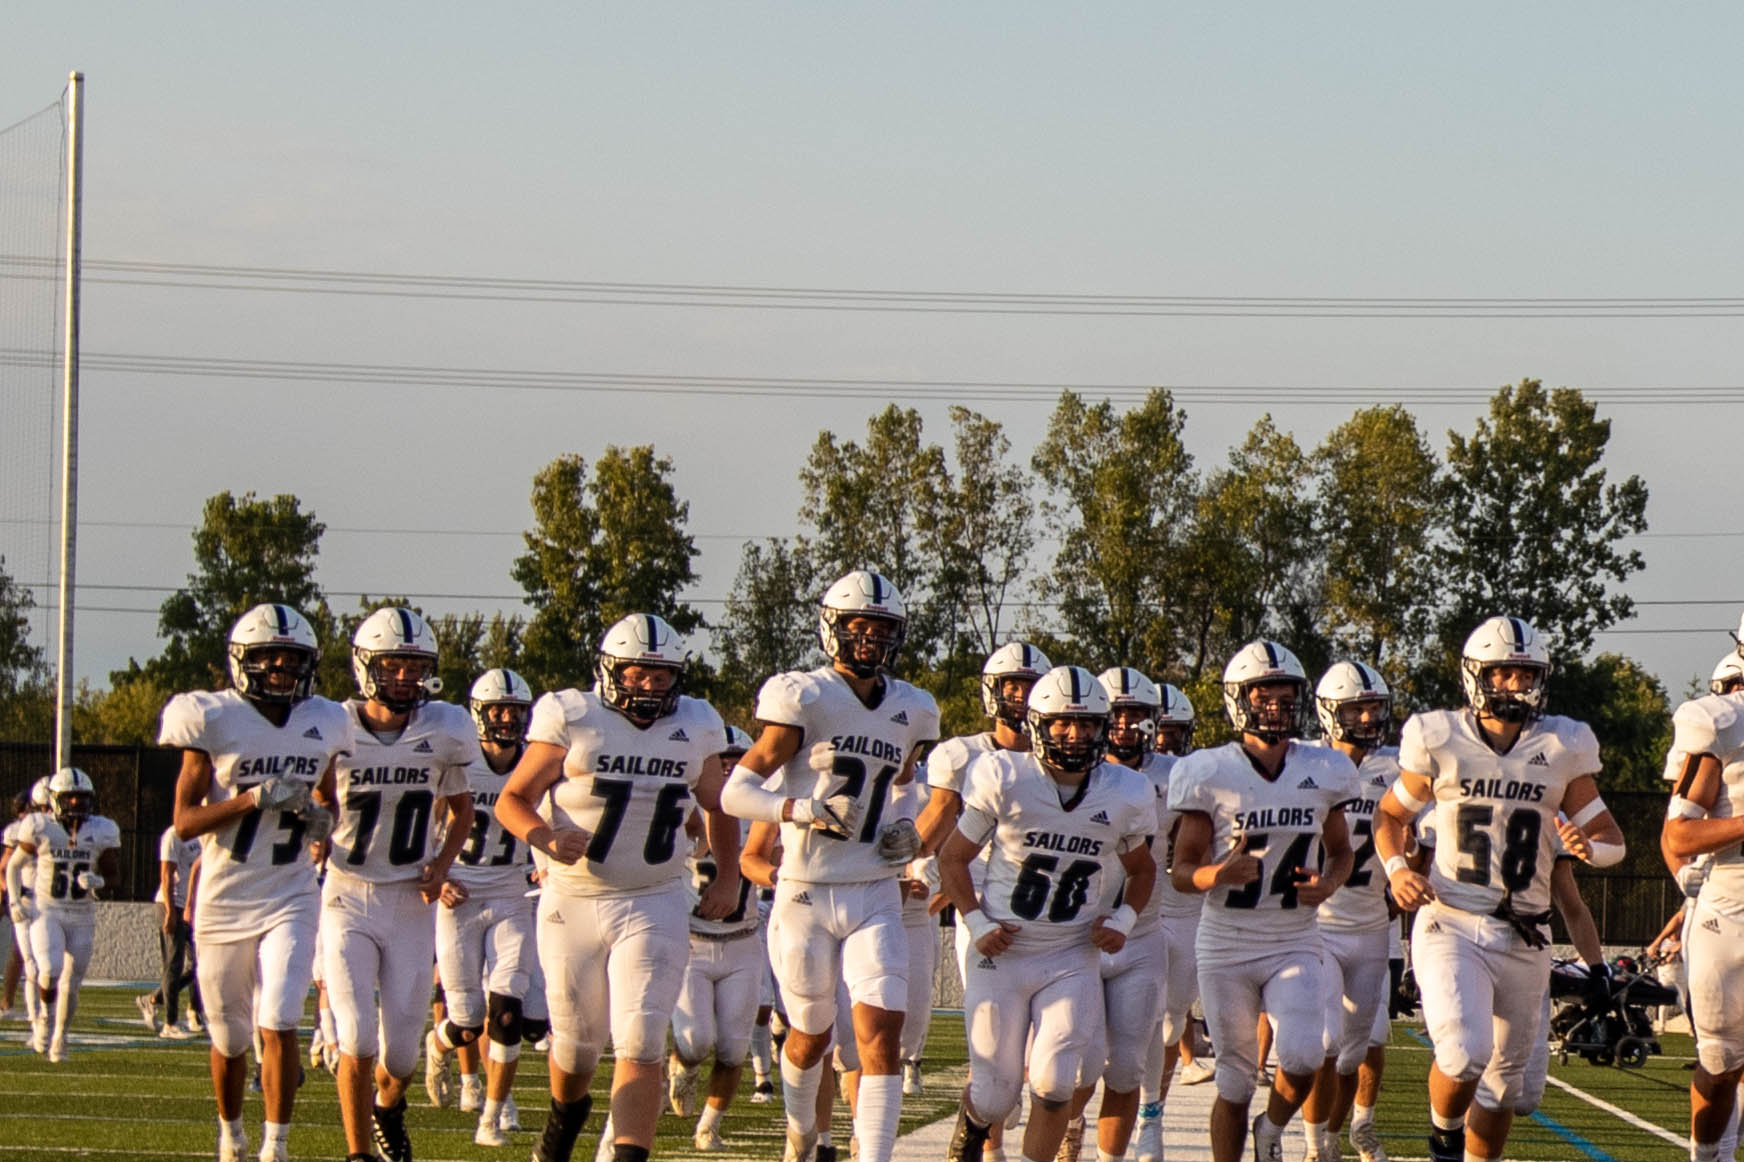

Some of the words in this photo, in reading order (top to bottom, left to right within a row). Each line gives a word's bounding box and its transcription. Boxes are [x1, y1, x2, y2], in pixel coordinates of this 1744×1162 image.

[828, 735, 902, 765] SAILORS
[239, 756, 319, 777] SAILORS
[350, 767, 430, 786] SAILORS
[596, 755, 688, 778] SAILORS
[817, 755, 899, 843] 21
[1460, 778, 1547, 803] SAILORS
[346, 789, 434, 866] 70
[585, 776, 691, 866] 76
[1233, 807, 1315, 831] SAILORS
[1023, 831, 1103, 857] SAILORS
[1456, 803, 1541, 892] 58
[1224, 832, 1316, 909] 54
[1010, 852, 1102, 923] 68
